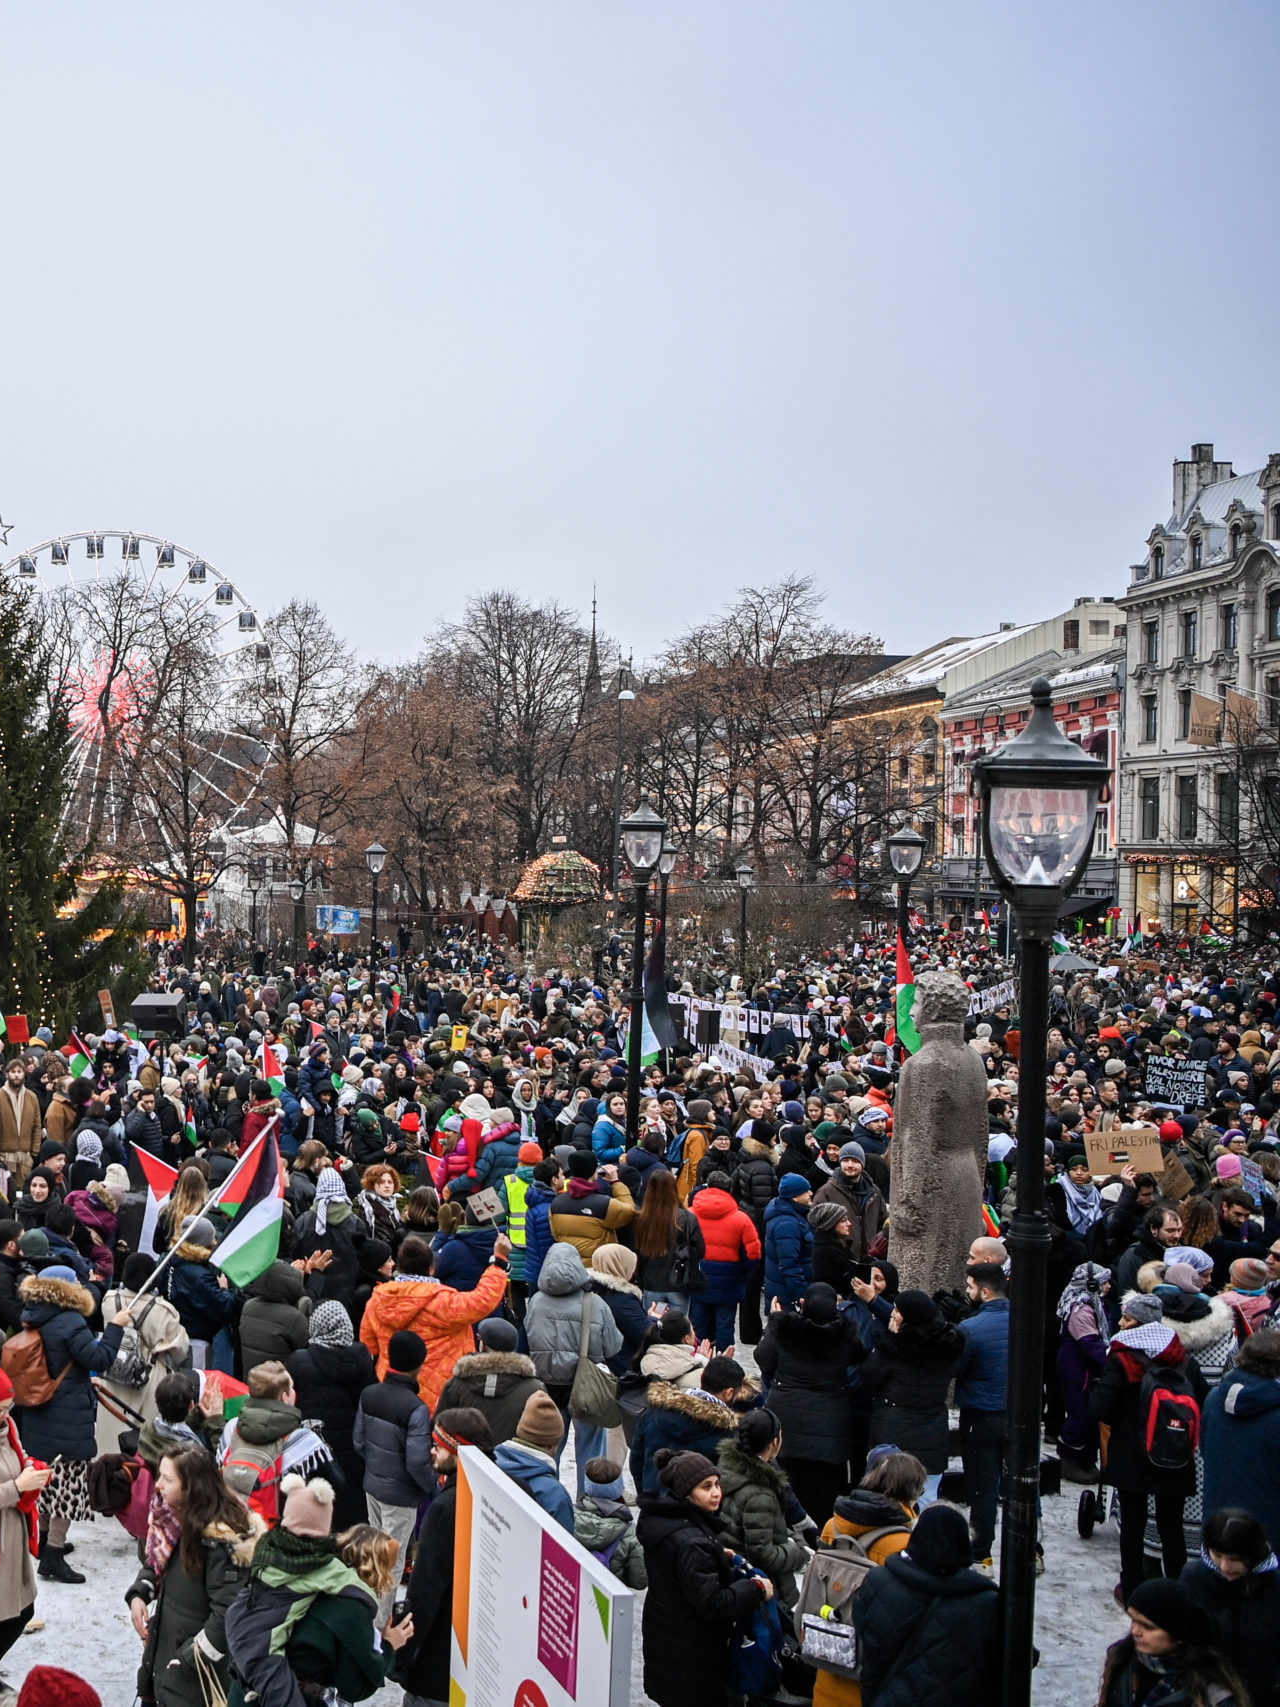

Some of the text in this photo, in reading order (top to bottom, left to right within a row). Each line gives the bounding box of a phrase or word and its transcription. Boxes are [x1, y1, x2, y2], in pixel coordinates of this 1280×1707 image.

[1147, 1055, 1208, 1071] HVOR MANGE
[1145, 1074, 1206, 1093] SKAL NORSKE
[1170, 1091, 1206, 1106] DREPE
[1090, 1140, 1109, 1152] FRI
